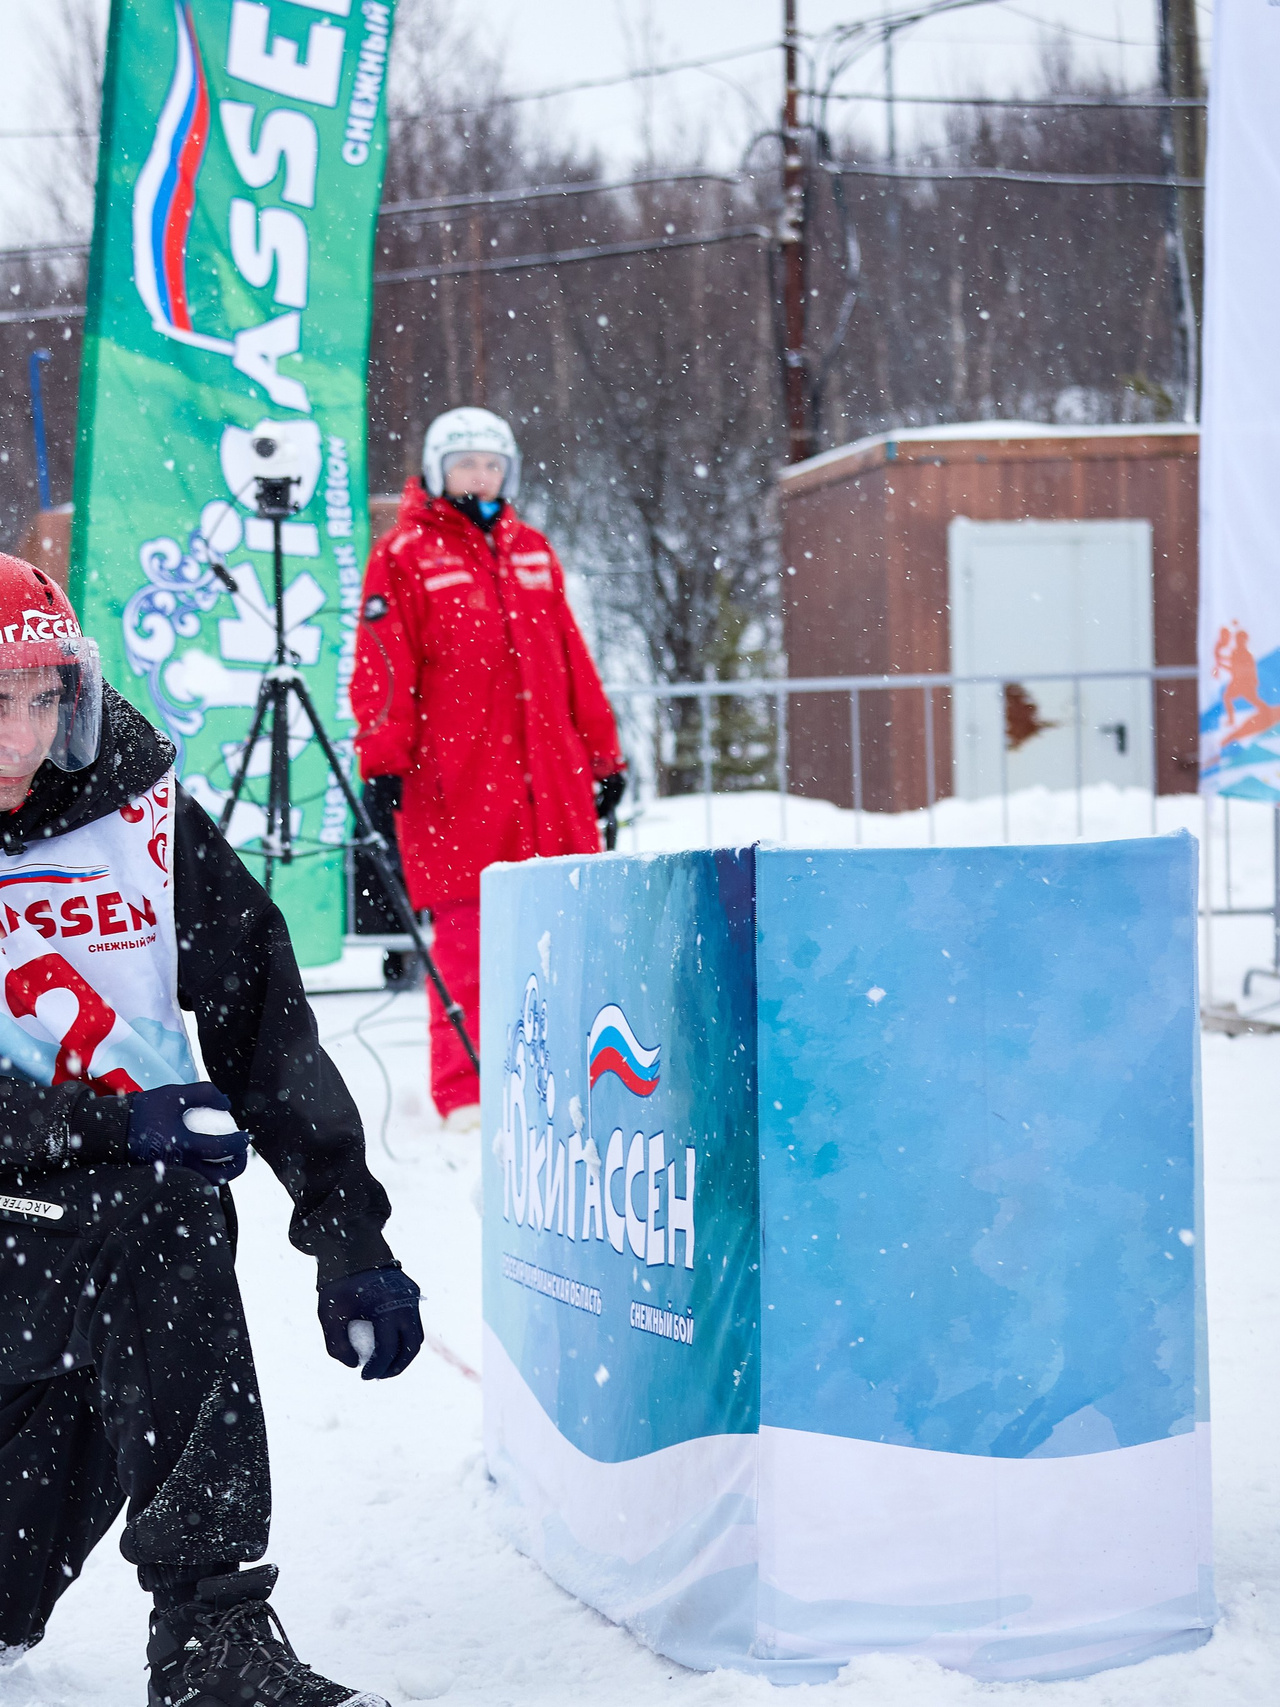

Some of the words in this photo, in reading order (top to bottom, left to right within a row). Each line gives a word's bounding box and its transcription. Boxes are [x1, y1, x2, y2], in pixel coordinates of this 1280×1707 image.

[88, 936, 146, 953] СНЕЖНЫЙ
[4, 952, 144, 1097] 2
[630, 1300, 673, 1340] СНЕЖНЫЙ
[673, 1306, 694, 1346] БОЙ
[171, 1688, 201, 1707] MPHIBIA
